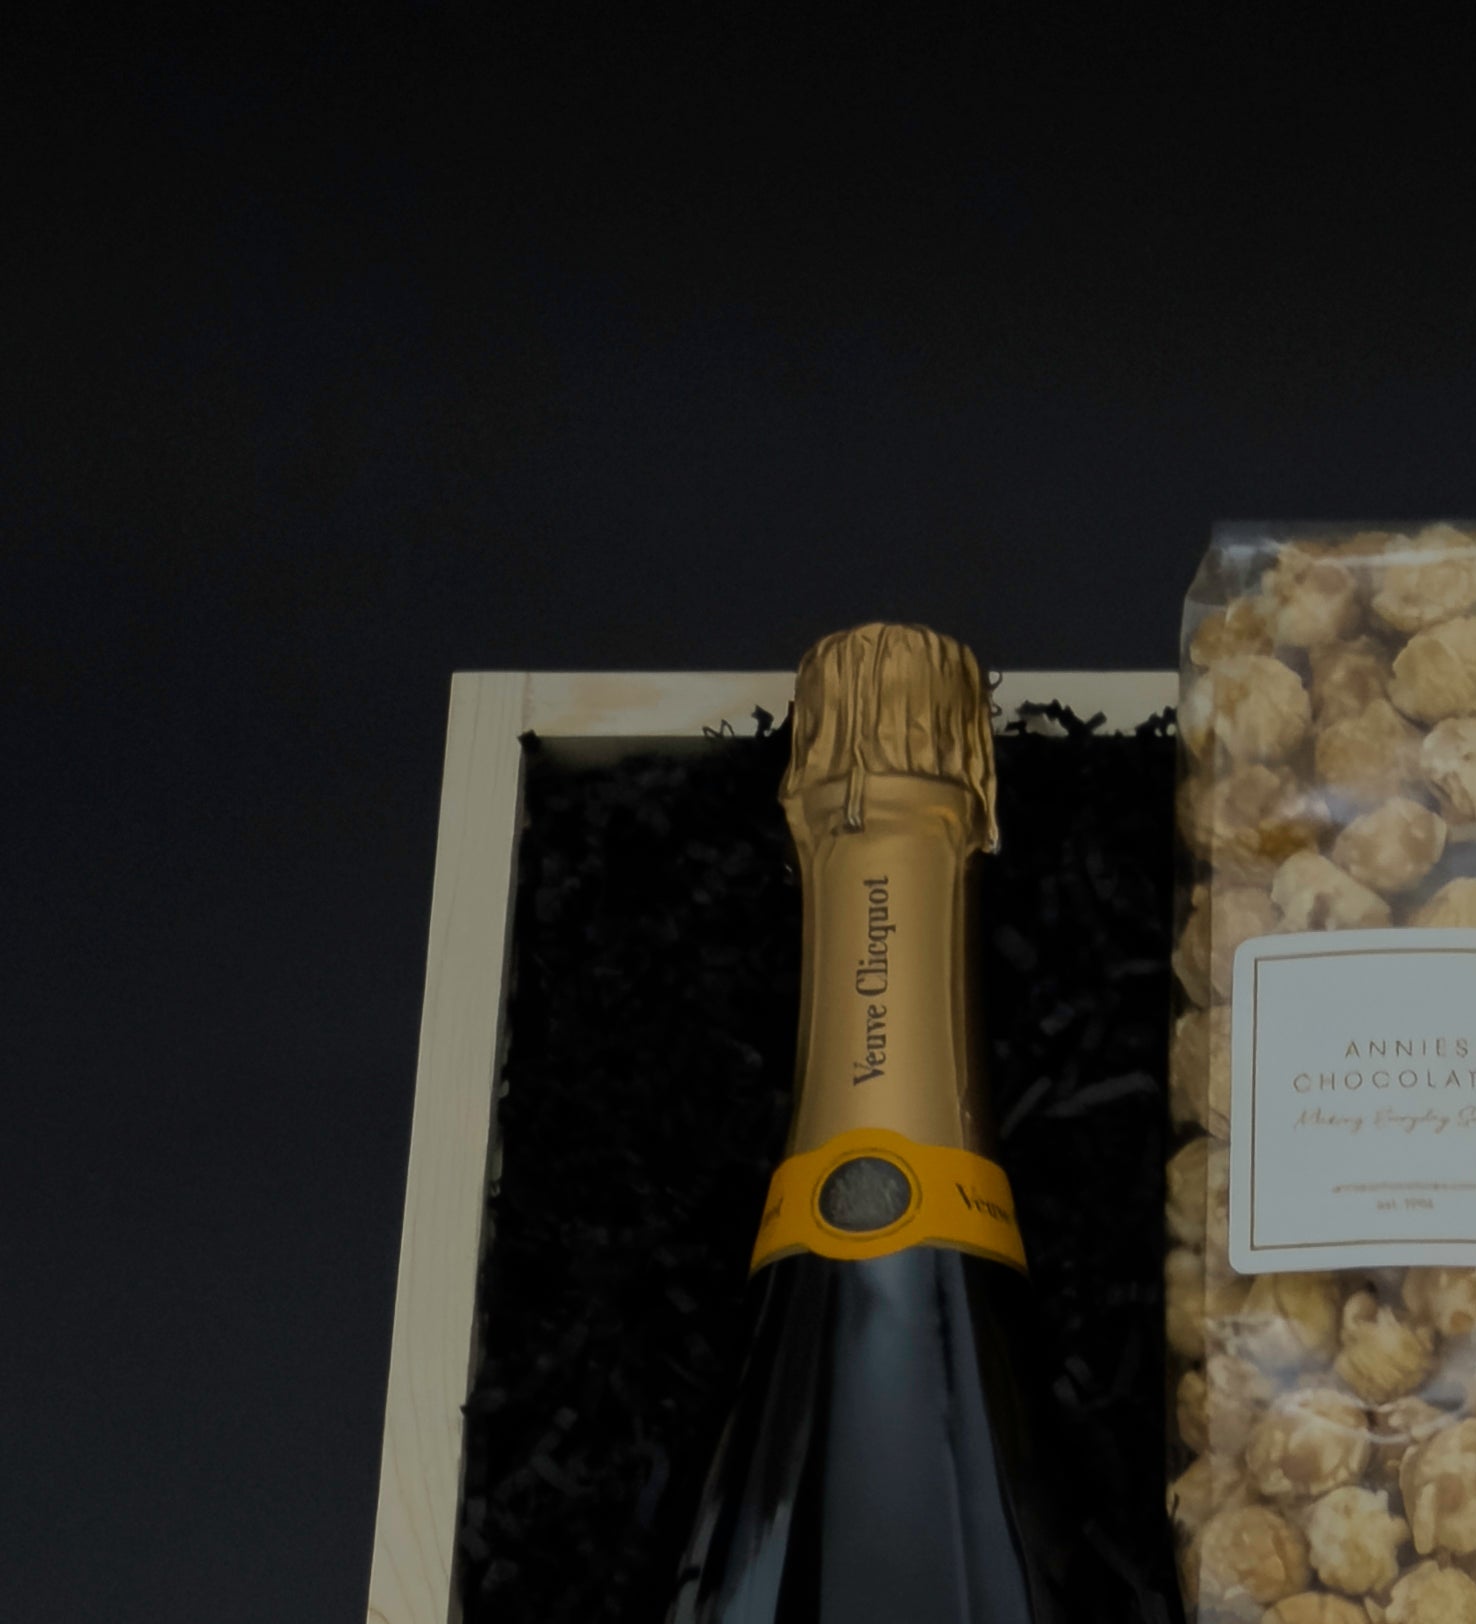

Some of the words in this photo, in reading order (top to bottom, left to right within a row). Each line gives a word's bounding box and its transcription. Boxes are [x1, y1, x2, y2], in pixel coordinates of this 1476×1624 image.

[855, 875, 896, 998] Clicquot
[852, 1003, 888, 1087] Veuve
[1344, 1038, 1473, 1059] ANNIES
